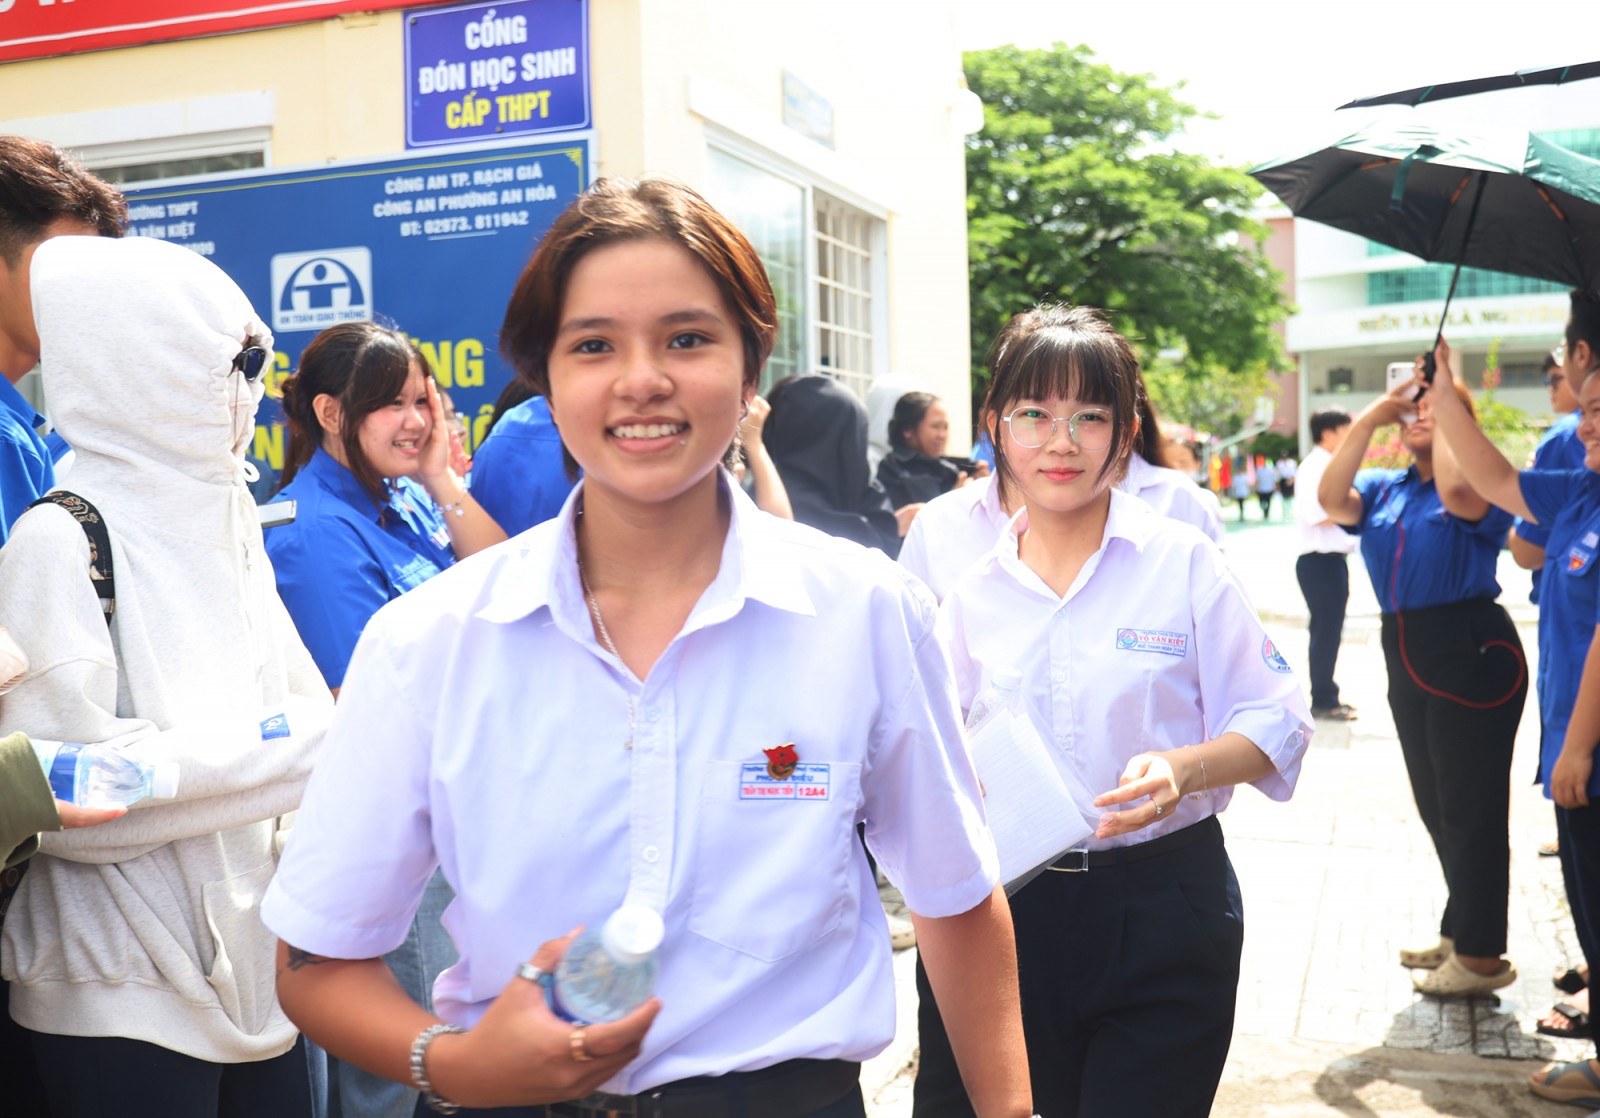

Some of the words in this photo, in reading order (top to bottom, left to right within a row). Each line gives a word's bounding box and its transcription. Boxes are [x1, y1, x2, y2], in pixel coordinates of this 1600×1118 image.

[465, 8, 528, 50] CỔNG
[418, 58, 467, 94] ĐÓN
[470, 55, 518, 92] HỌC
[521, 46, 577, 82] SINH
[445, 90, 491, 129] CẤP
[495, 90, 551, 123] THPT
[385, 177, 424, 195] CÔNG
[427, 174, 448, 190] AN
[451, 171, 472, 188] TP.
[473, 167, 514, 187] RẠCH
[516, 161, 543, 181] GIÁ
[373, 199, 413, 217] CÔNG
[415, 197, 436, 213] AN
[438, 190, 498, 211] PHƯỜNG
[501, 188, 523, 204] AN
[525, 183, 557, 202] HÒA
[799, 787, 826, 797] 12A4
